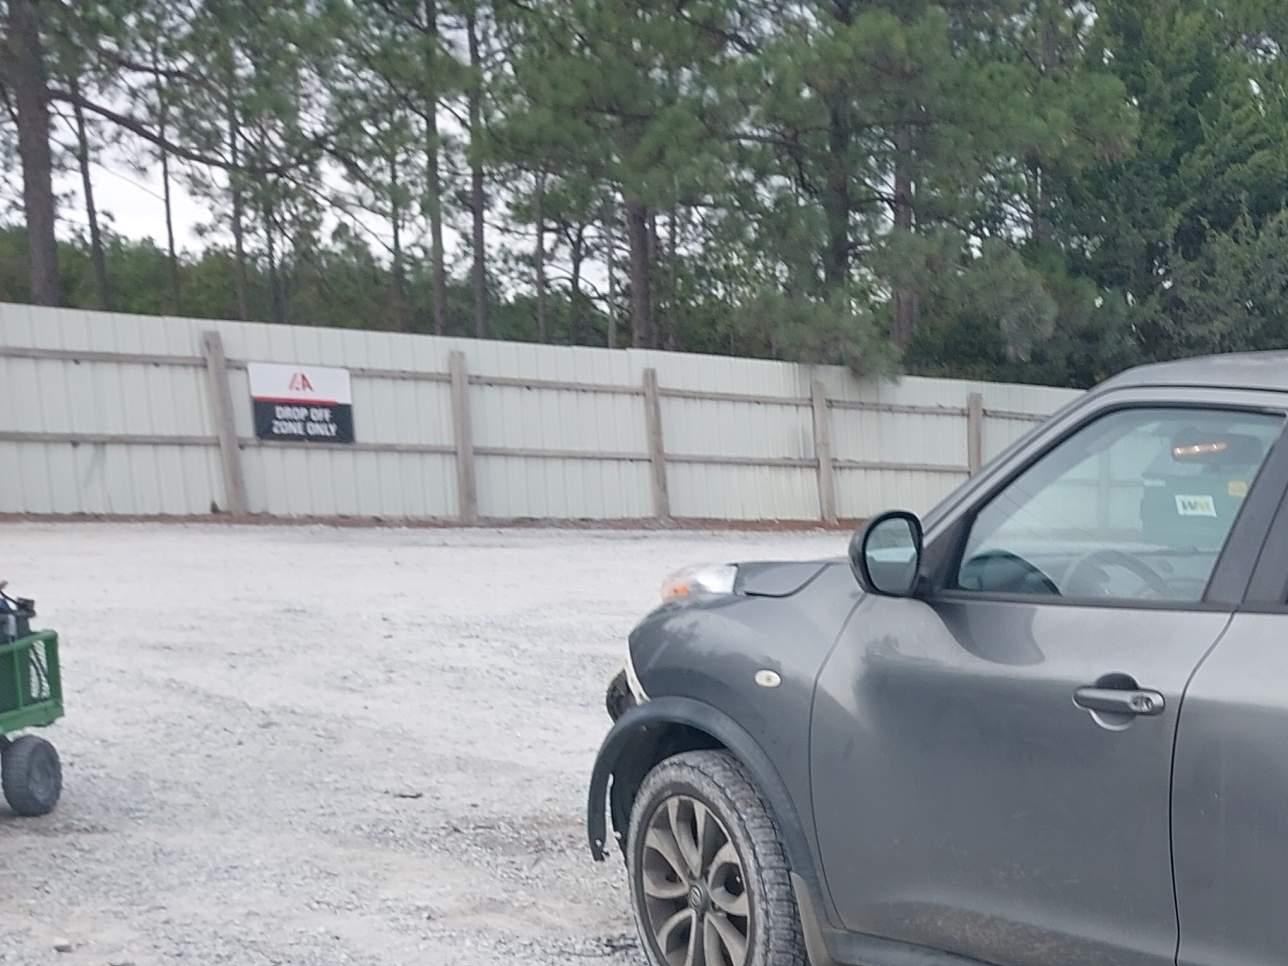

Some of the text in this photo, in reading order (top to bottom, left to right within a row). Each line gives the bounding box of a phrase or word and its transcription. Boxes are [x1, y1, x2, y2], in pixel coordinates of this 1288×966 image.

[275, 405, 331, 422] DROP OFF
[272, 420, 338, 436] ZONE ONLY
